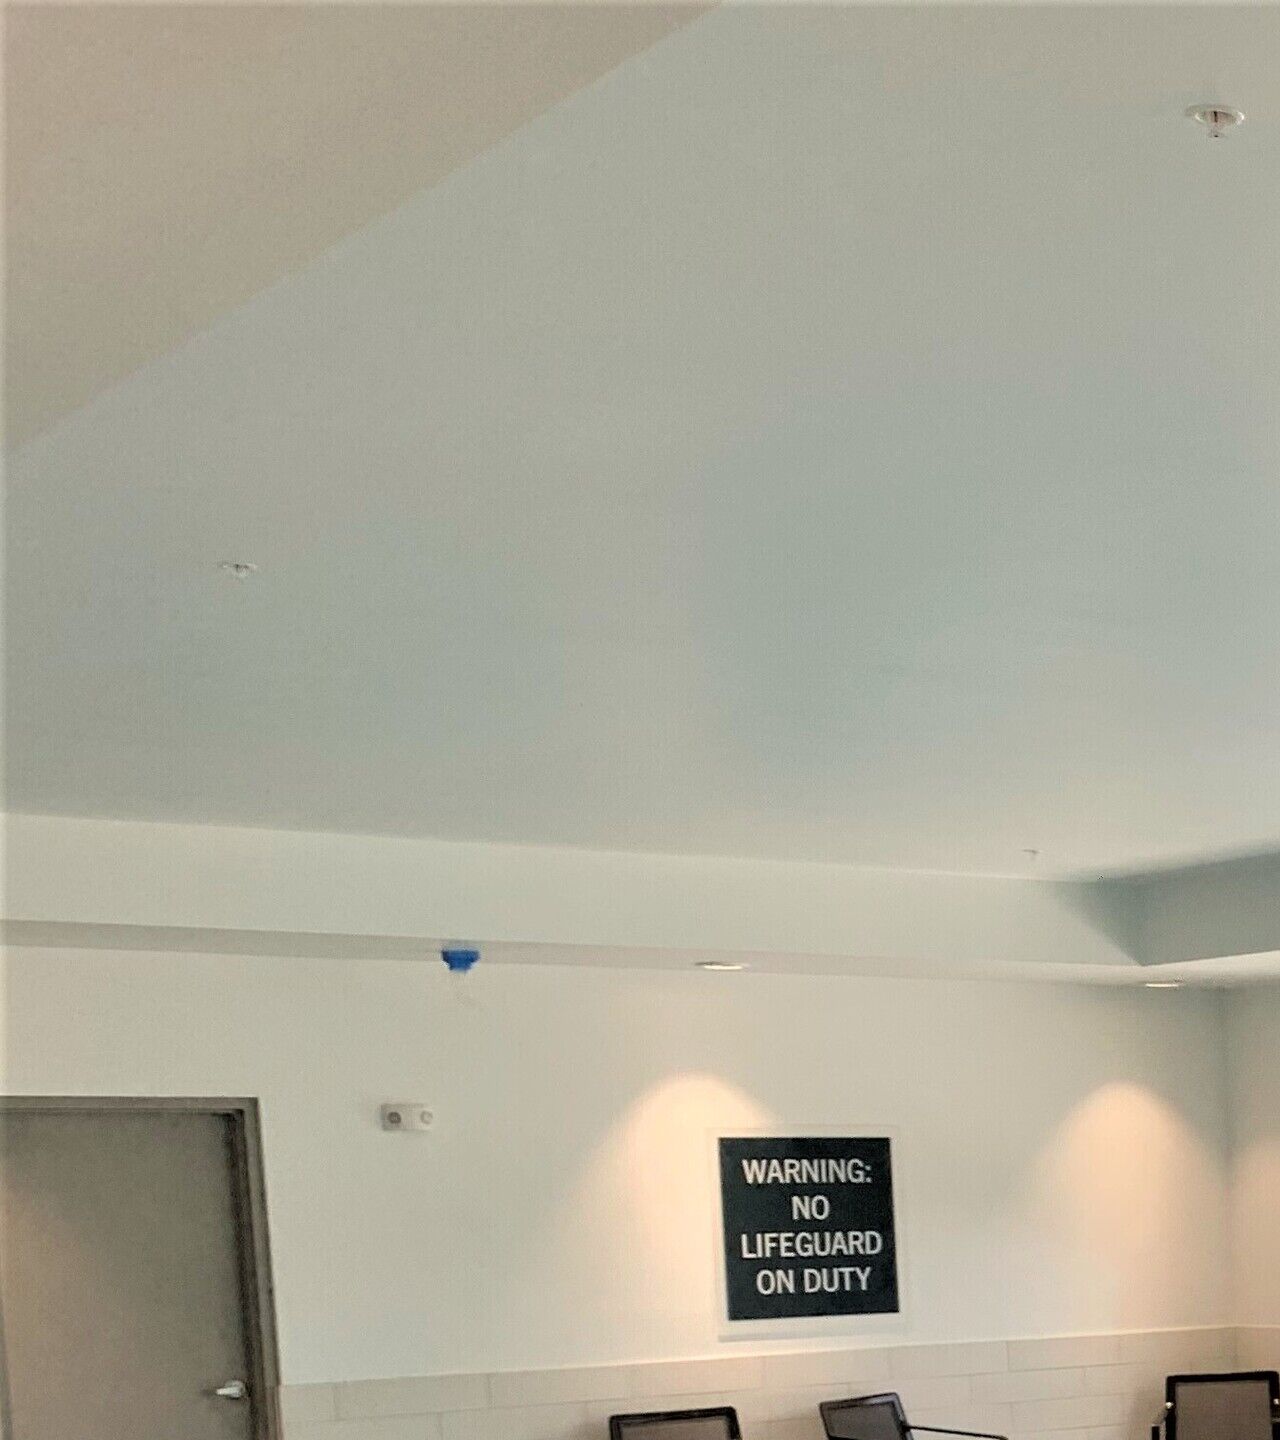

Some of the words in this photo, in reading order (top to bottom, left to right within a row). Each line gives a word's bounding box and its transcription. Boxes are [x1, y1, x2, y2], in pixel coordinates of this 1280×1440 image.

[741, 1158, 873, 1184] WARNING:
[791, 1195, 830, 1220] NO
[741, 1230, 883, 1258] LIFEGUARD
[756, 1269, 795, 1295] ON
[803, 1266, 871, 1293] DUTY
